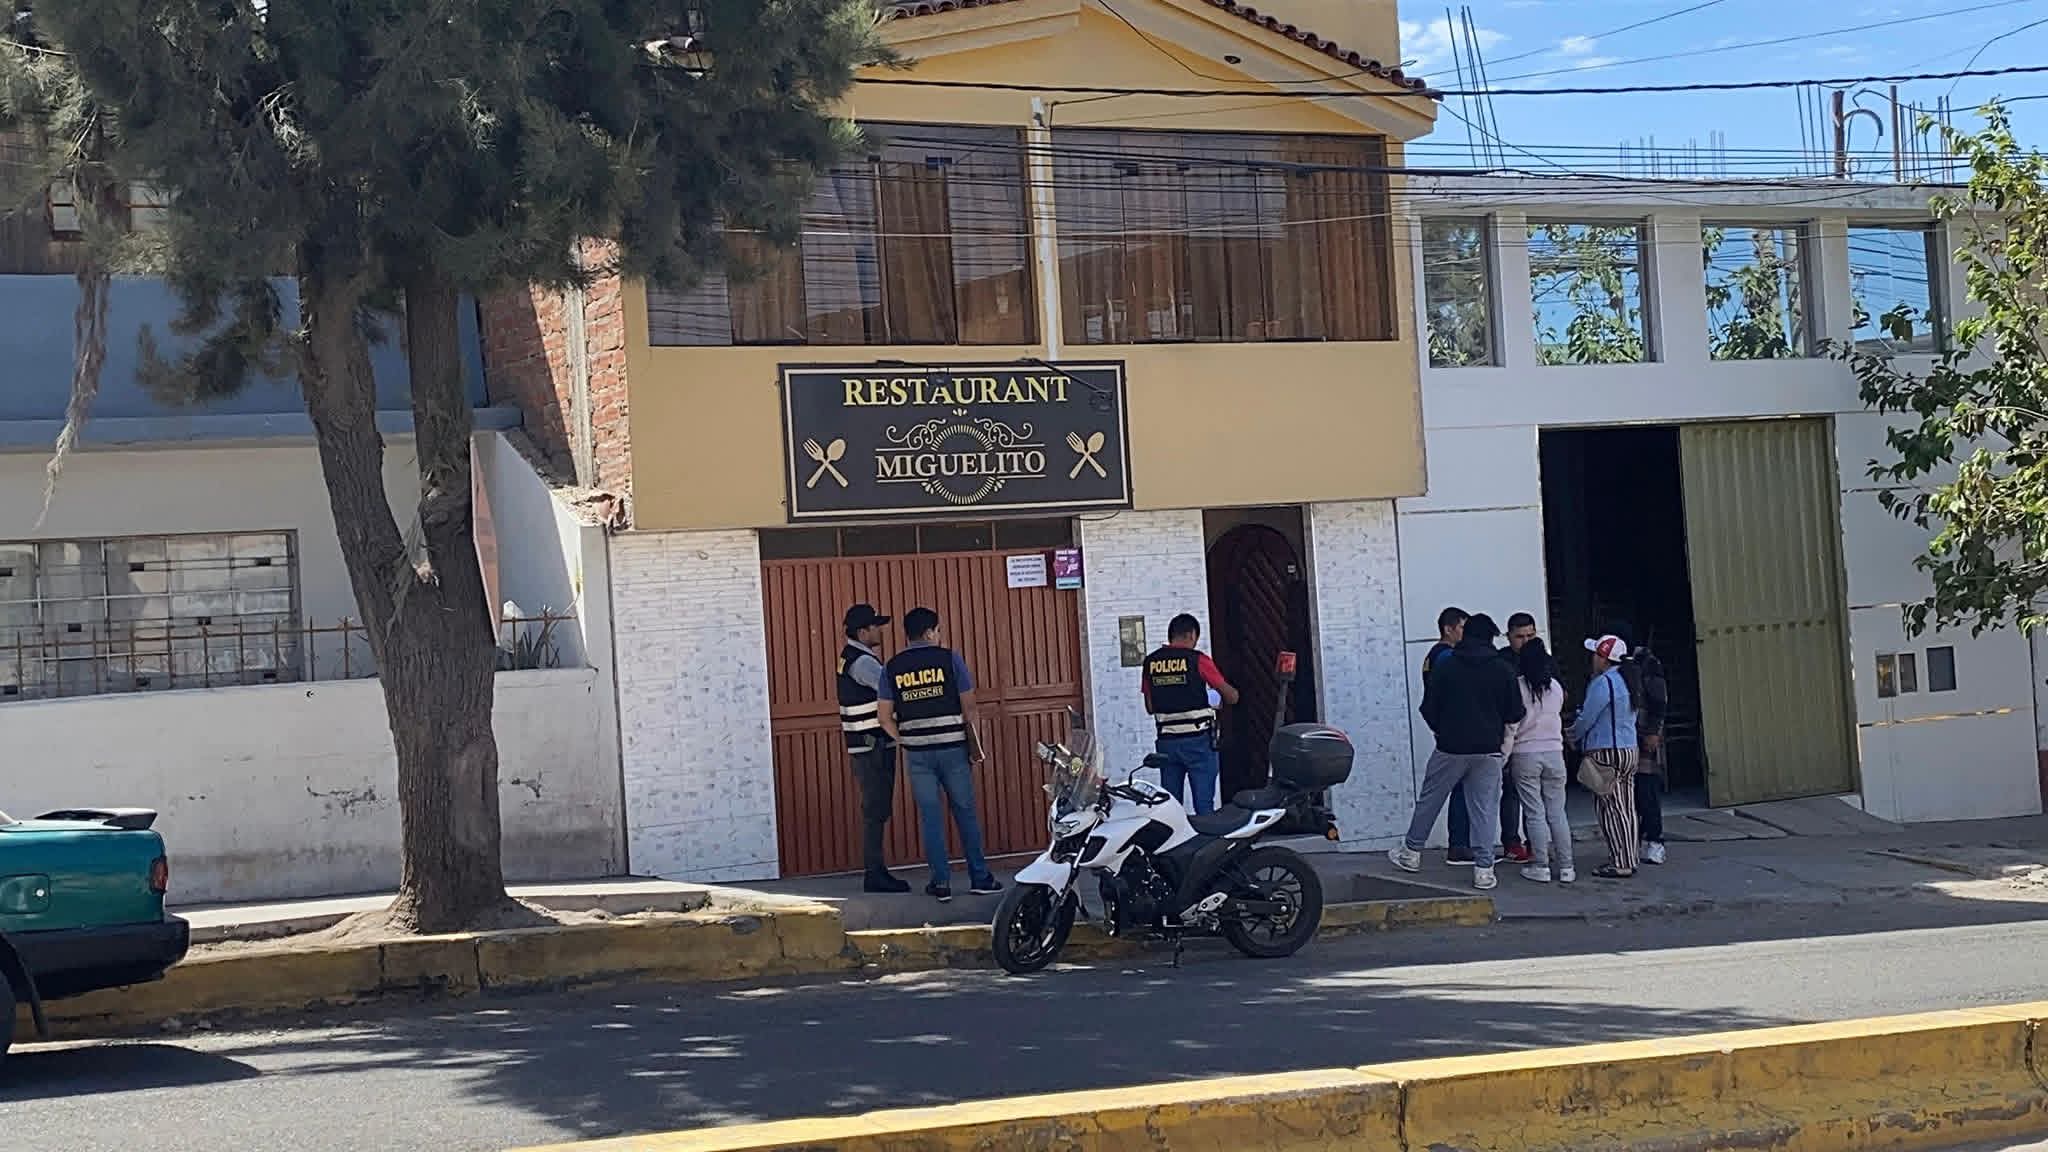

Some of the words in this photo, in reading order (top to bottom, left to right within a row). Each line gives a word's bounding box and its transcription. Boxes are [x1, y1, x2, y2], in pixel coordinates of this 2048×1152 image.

[841, 376, 1071, 406] RESTAURANT
[875, 450, 1046, 478] MIGUELITO
[1149, 658, 1188, 674] POLICIA
[895, 668, 945, 689] POLICIA
